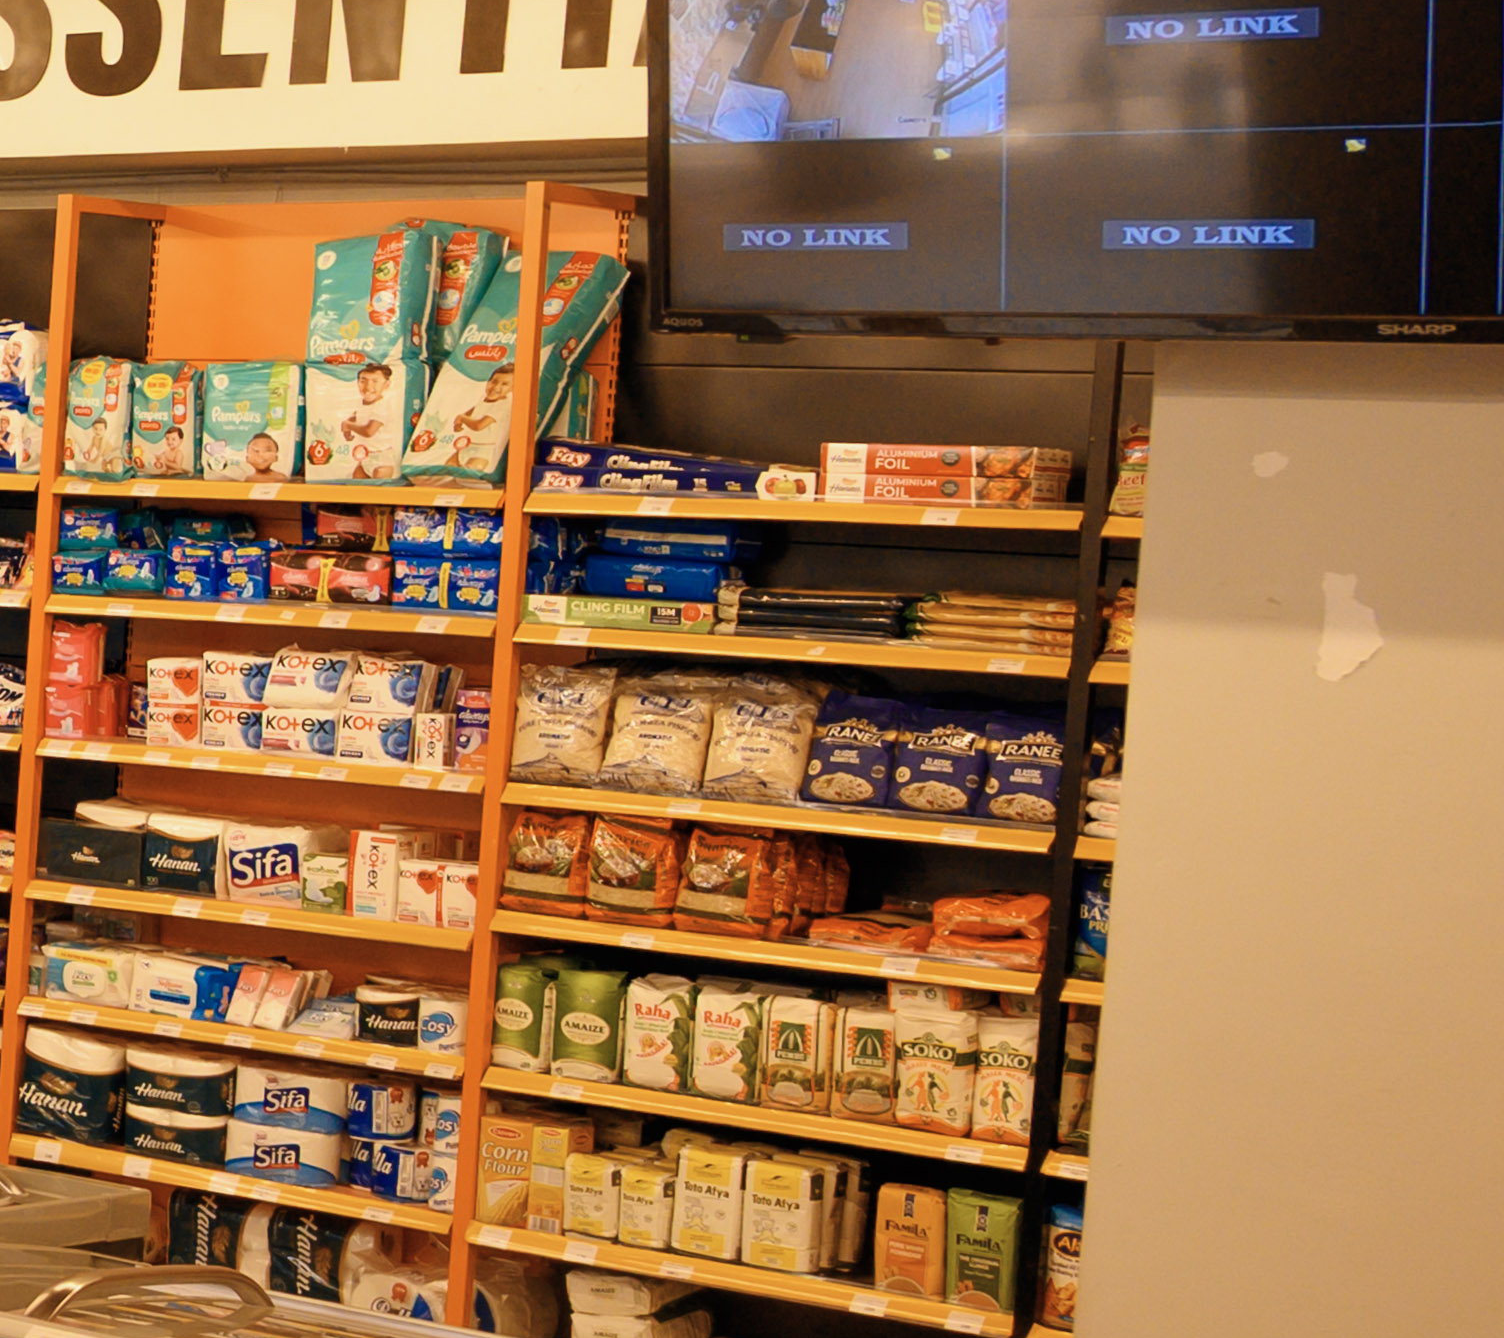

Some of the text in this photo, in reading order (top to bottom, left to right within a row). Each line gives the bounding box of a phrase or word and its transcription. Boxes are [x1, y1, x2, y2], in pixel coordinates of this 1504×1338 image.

[1124, 11, 1300, 40] NO LINK
[740, 226, 891, 249] NO LINK
[1122, 224, 1295, 247] NO LINK
[1376, 322, 1457, 335] SHARP
[310, 335, 375, 361] Pampers
[211, 410, 261, 424] Pampers
[336, 444, 350, 456] 48
[548, 447, 591, 467] Fay
[877, 449, 938, 459] ALUMINIUM
[875, 458, 910, 470] FOIL
[876, 478, 937, 488] ALUMINIUM
[874, 487, 909, 498] FOIL
[571, 601, 609, 613] CLING
[614, 604, 645, 615] FILM
[1004, 744, 1061, 759] RANEE
[232, 848, 293, 886] Sifa
[496, 1006, 528, 1019] AMAIZE
[634, 1004, 671, 1021] Raha
[704, 1011, 742, 1028] Raha
[421, 1017, 454, 1033] Cosy
[564, 1020, 606, 1034] AMAIZE
[903, 1043, 953, 1060] SOKO
[980, 1052, 1030, 1068] SOKO
[265, 1089, 306, 1112] Sifa
[256, 1145, 296, 1167] Sifa
[481, 1142, 528, 1163] Corn
[484, 1158, 527, 1176] Flour
[684, 1180, 730, 1199] Toto Afya
[752, 1194, 800, 1212] Toto Afya
